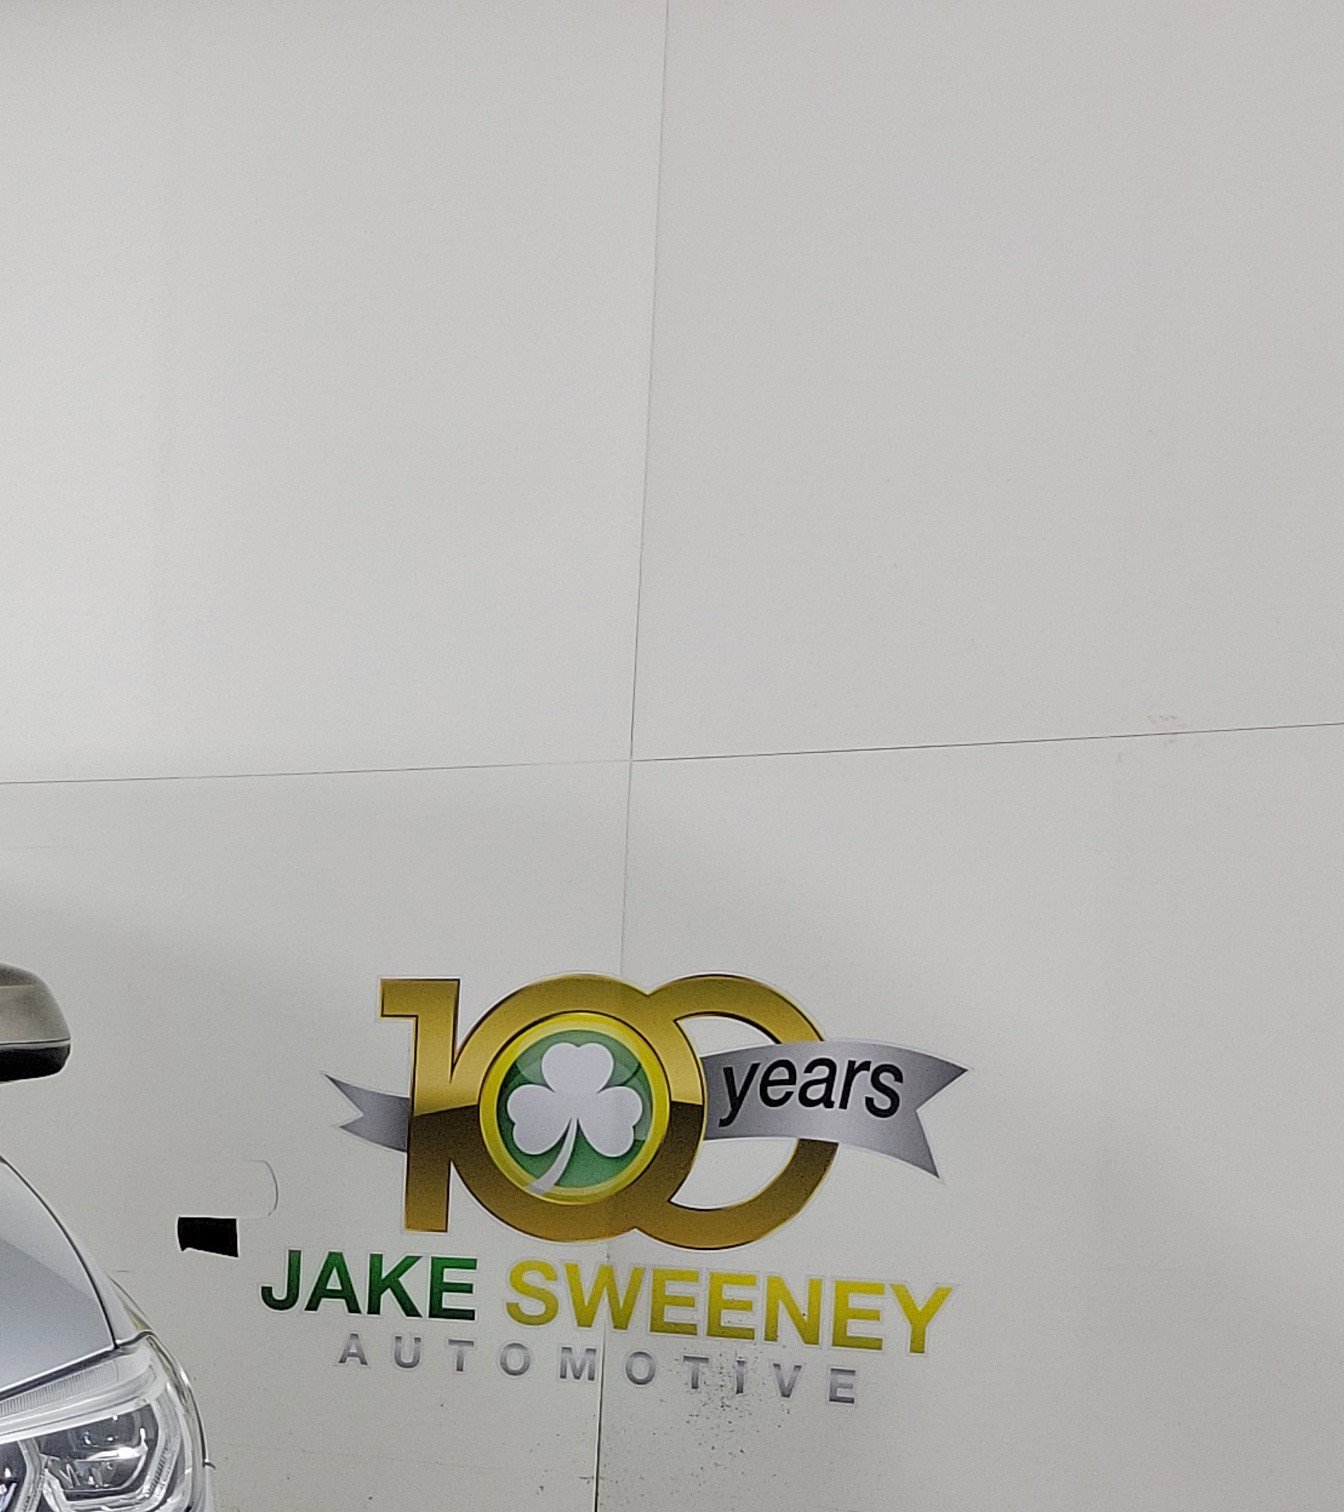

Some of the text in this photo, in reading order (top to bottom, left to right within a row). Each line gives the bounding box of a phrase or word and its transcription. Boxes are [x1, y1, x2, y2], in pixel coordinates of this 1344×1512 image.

[718, 1056, 905, 1128] years
[259, 1249, 954, 1355] JAKE SWEENEY
[338, 1332, 857, 1404] AUTOMOTIVE
